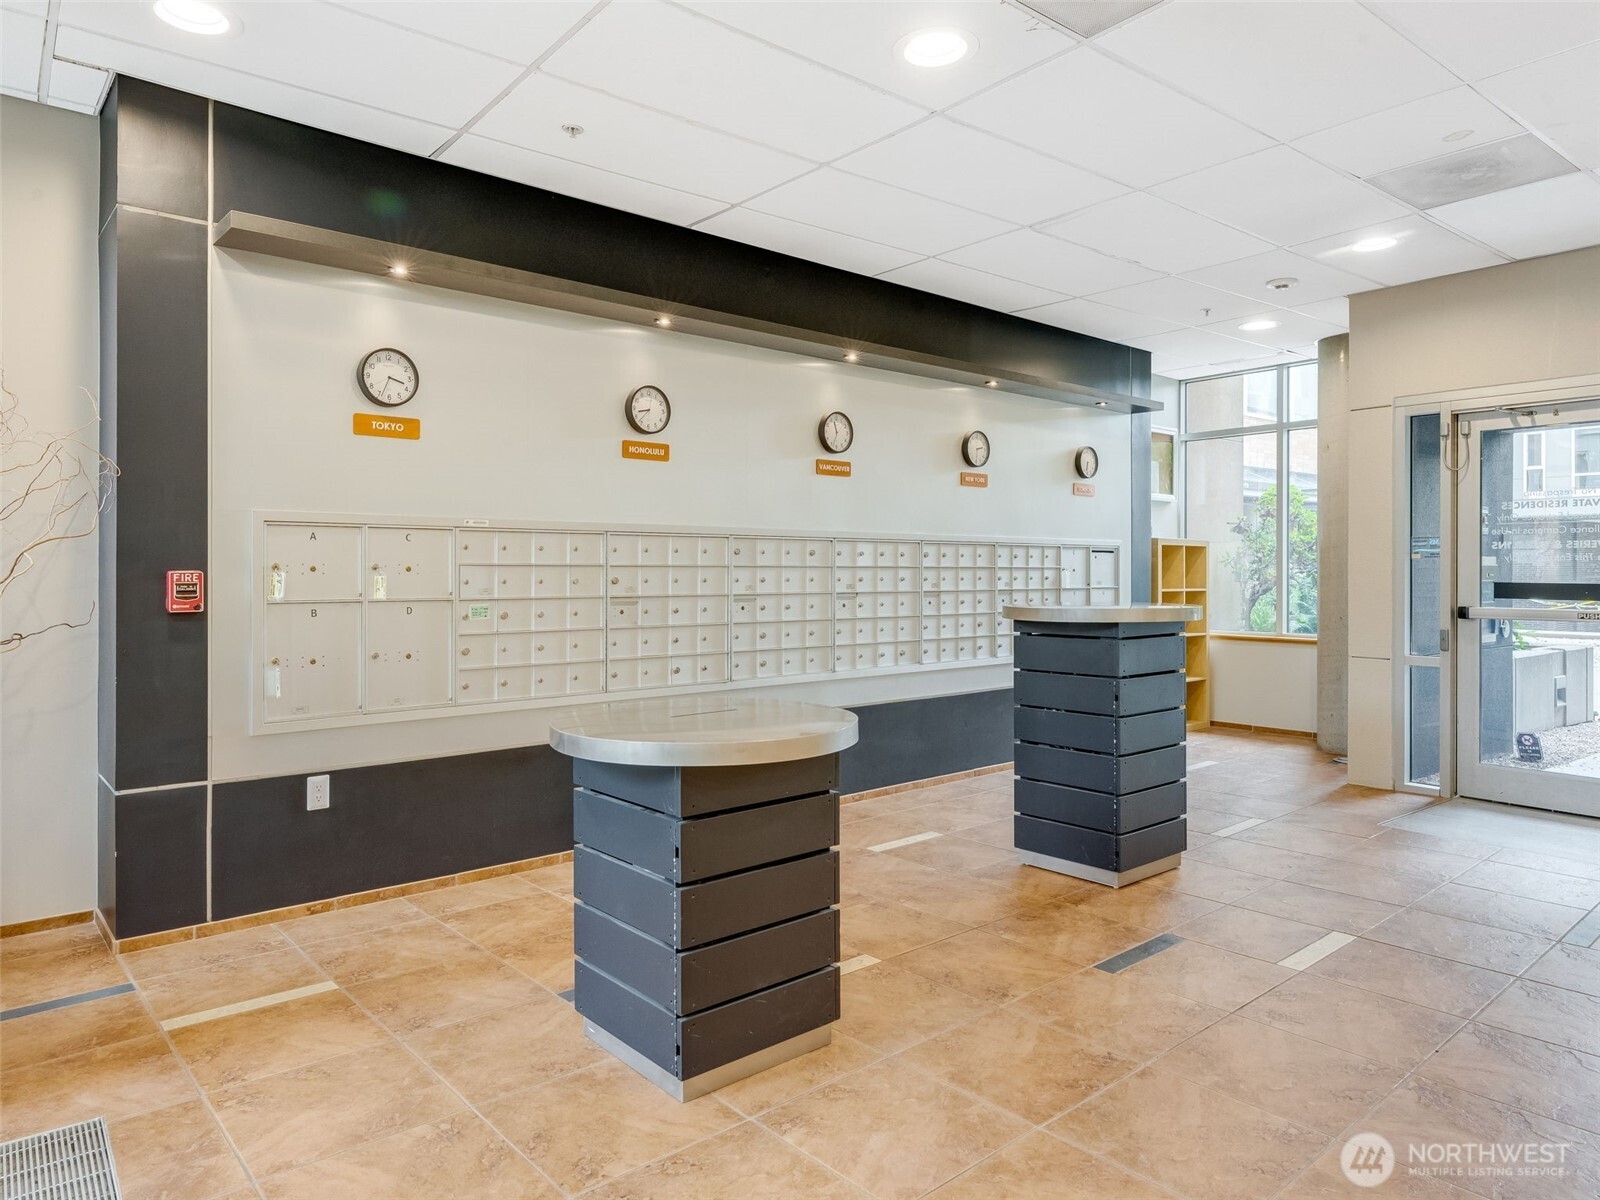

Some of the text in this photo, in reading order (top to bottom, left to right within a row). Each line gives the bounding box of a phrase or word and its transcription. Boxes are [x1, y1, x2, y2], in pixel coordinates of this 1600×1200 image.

[371, 421, 404, 432] TOKYO
[628, 445, 665, 456] HONOLULU
[818, 463, 850, 472] VANCOUVER
[310, 532, 316, 540] A
[405, 533, 411, 542] C
[173, 573, 200, 582] FIRE
[310, 608, 318, 618] B
[406, 606, 412, 614] D
